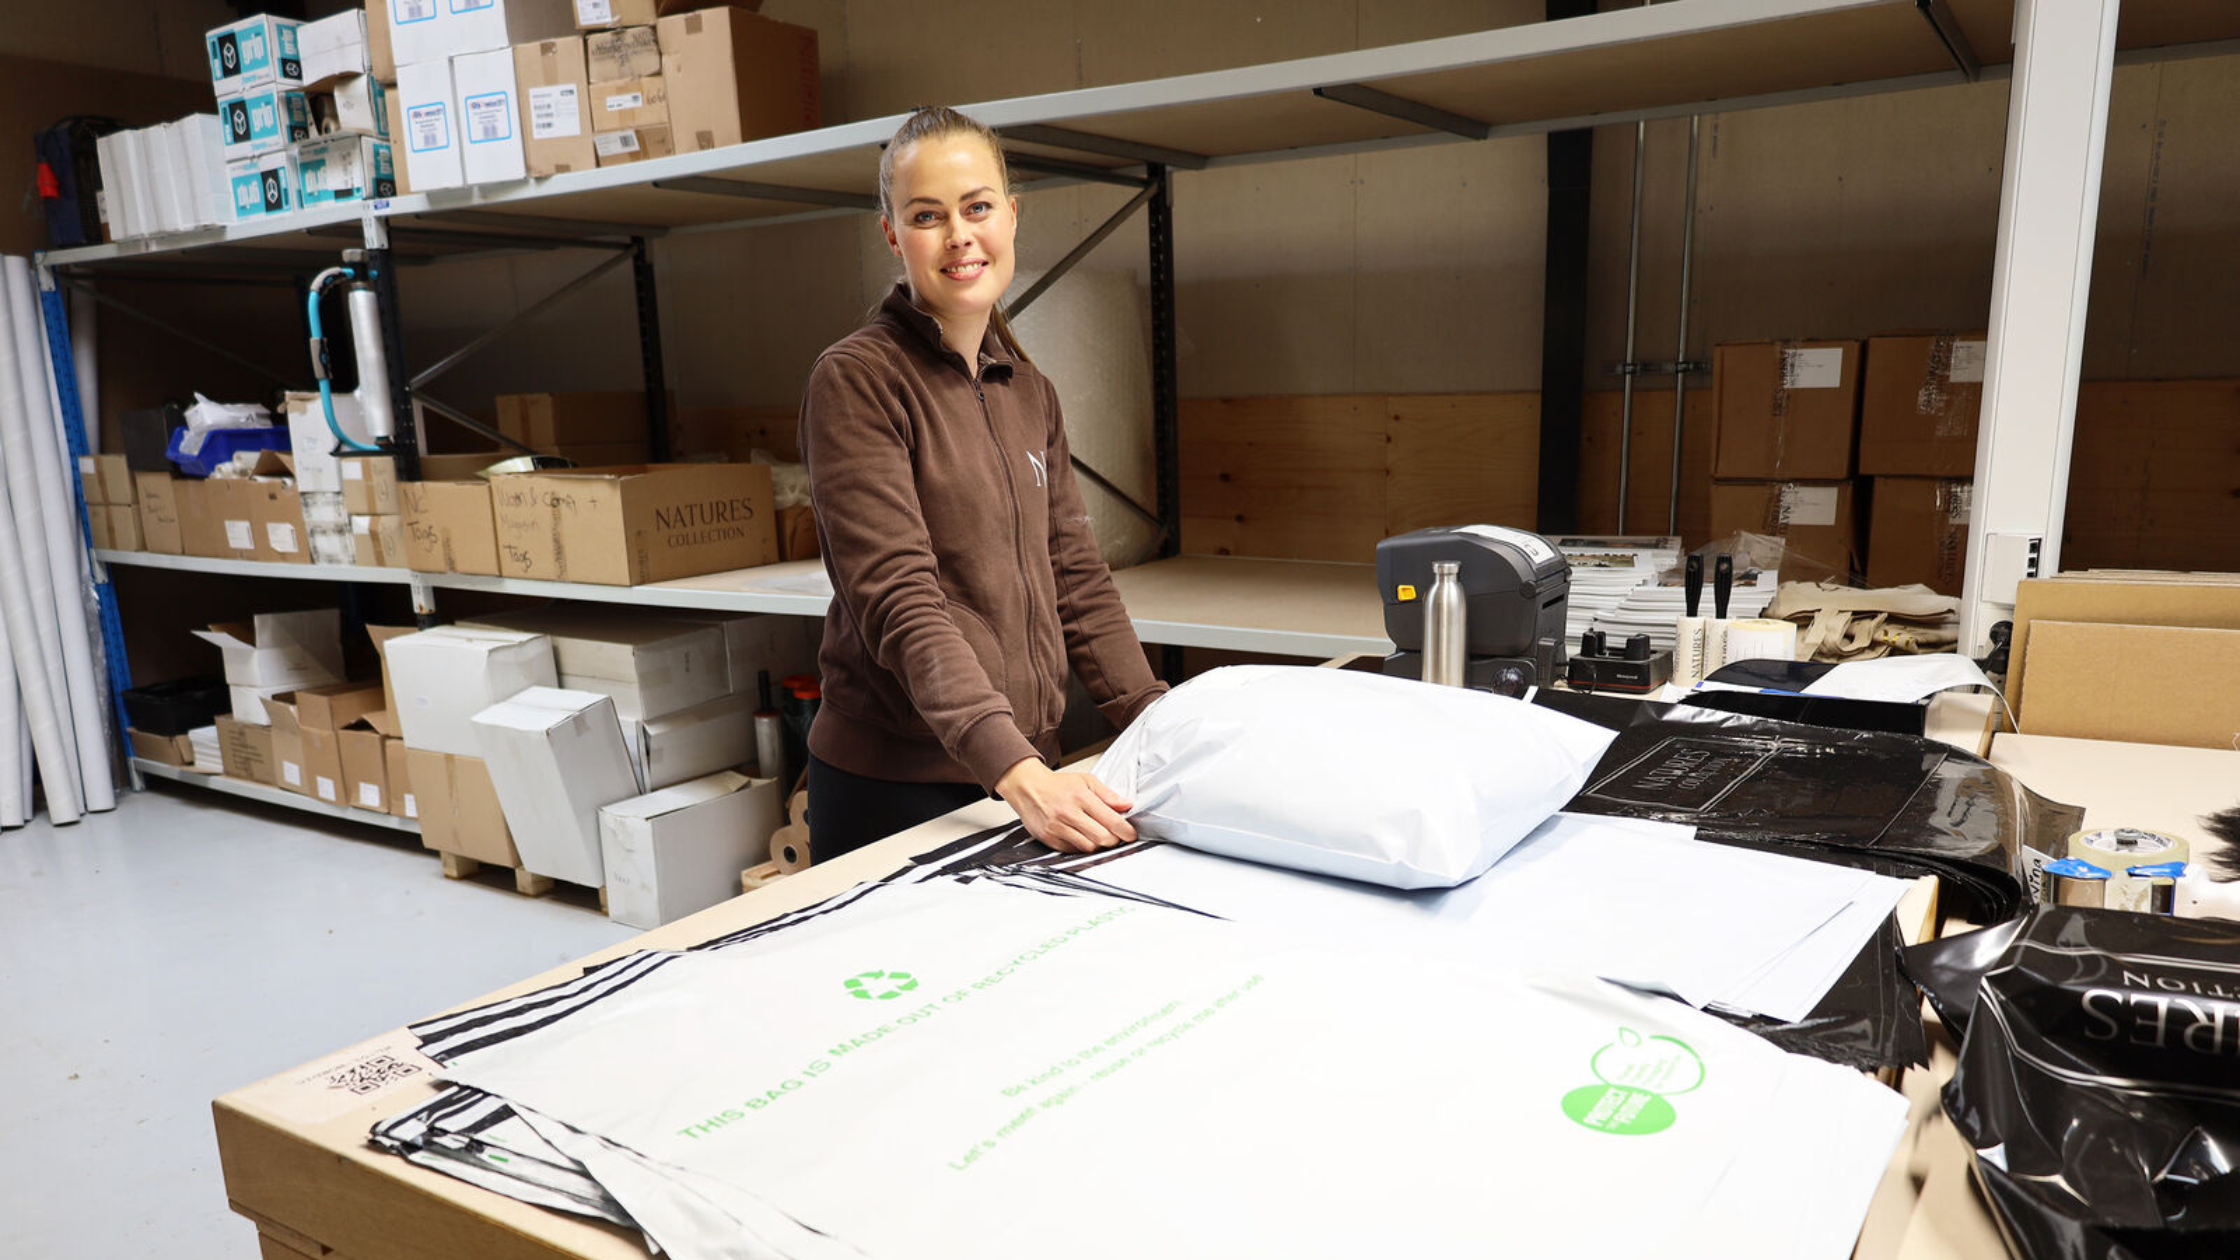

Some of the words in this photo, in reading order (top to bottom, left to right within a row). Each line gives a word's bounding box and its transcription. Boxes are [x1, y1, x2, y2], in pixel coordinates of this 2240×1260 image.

[241, 33, 265, 66] grip
[252, 102, 274, 132] grip
[236, 179, 261, 210] grip
[1025, 450, 1048, 488] N
[655, 496, 754, 532] NATURES
[406, 520, 439, 551] Tags
[667, 525, 746, 549] COLLECTION
[502, 544, 533, 573] Tags
[1690, 628, 1703, 679] NATURES
[1632, 747, 1710, 791] NATURES
[676, 1108, 746, 1139] THIS
[744, 1078, 806, 1110] BAG
[801, 1058, 831, 1078] IS
[827, 1024, 897, 1057] MADE
[896, 1003, 941, 1026] OUT
[942, 989, 969, 1004] OF
[970, 935, 1066, 990] RECYCLED
[2081, 988, 2240, 1053] RES
[999, 1084, 1030, 1098] Be
[1030, 1065, 1064, 1087] kind
[1077, 1043, 1106, 1059] the
[945, 1138, 997, 1175] Let's
[1038, 1084, 1082, 1109] again
[1089, 1057, 1132, 1082] reuse
